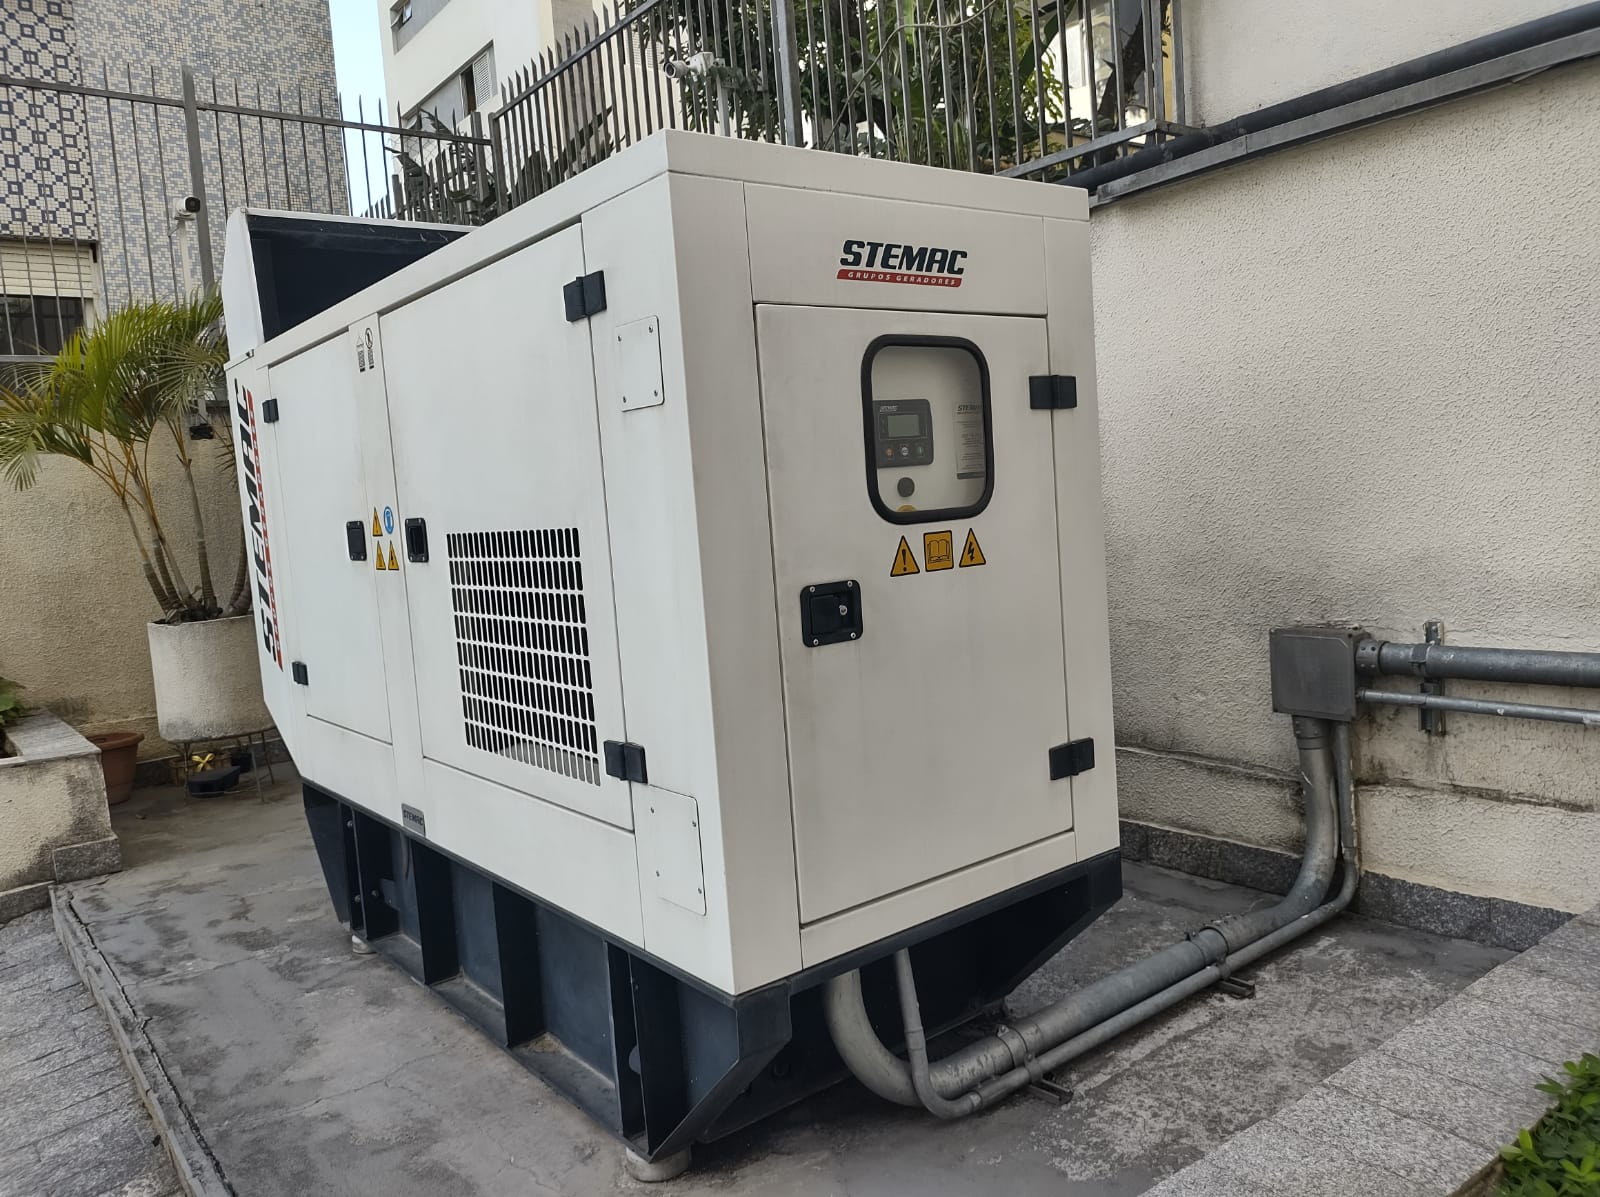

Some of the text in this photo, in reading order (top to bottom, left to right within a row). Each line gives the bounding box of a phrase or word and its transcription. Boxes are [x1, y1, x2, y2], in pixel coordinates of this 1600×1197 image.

[840, 239, 968, 275] STEMAC
[848, 272, 957, 286] GRUPOS GERADORES
[234, 378, 278, 663] STEMAC
